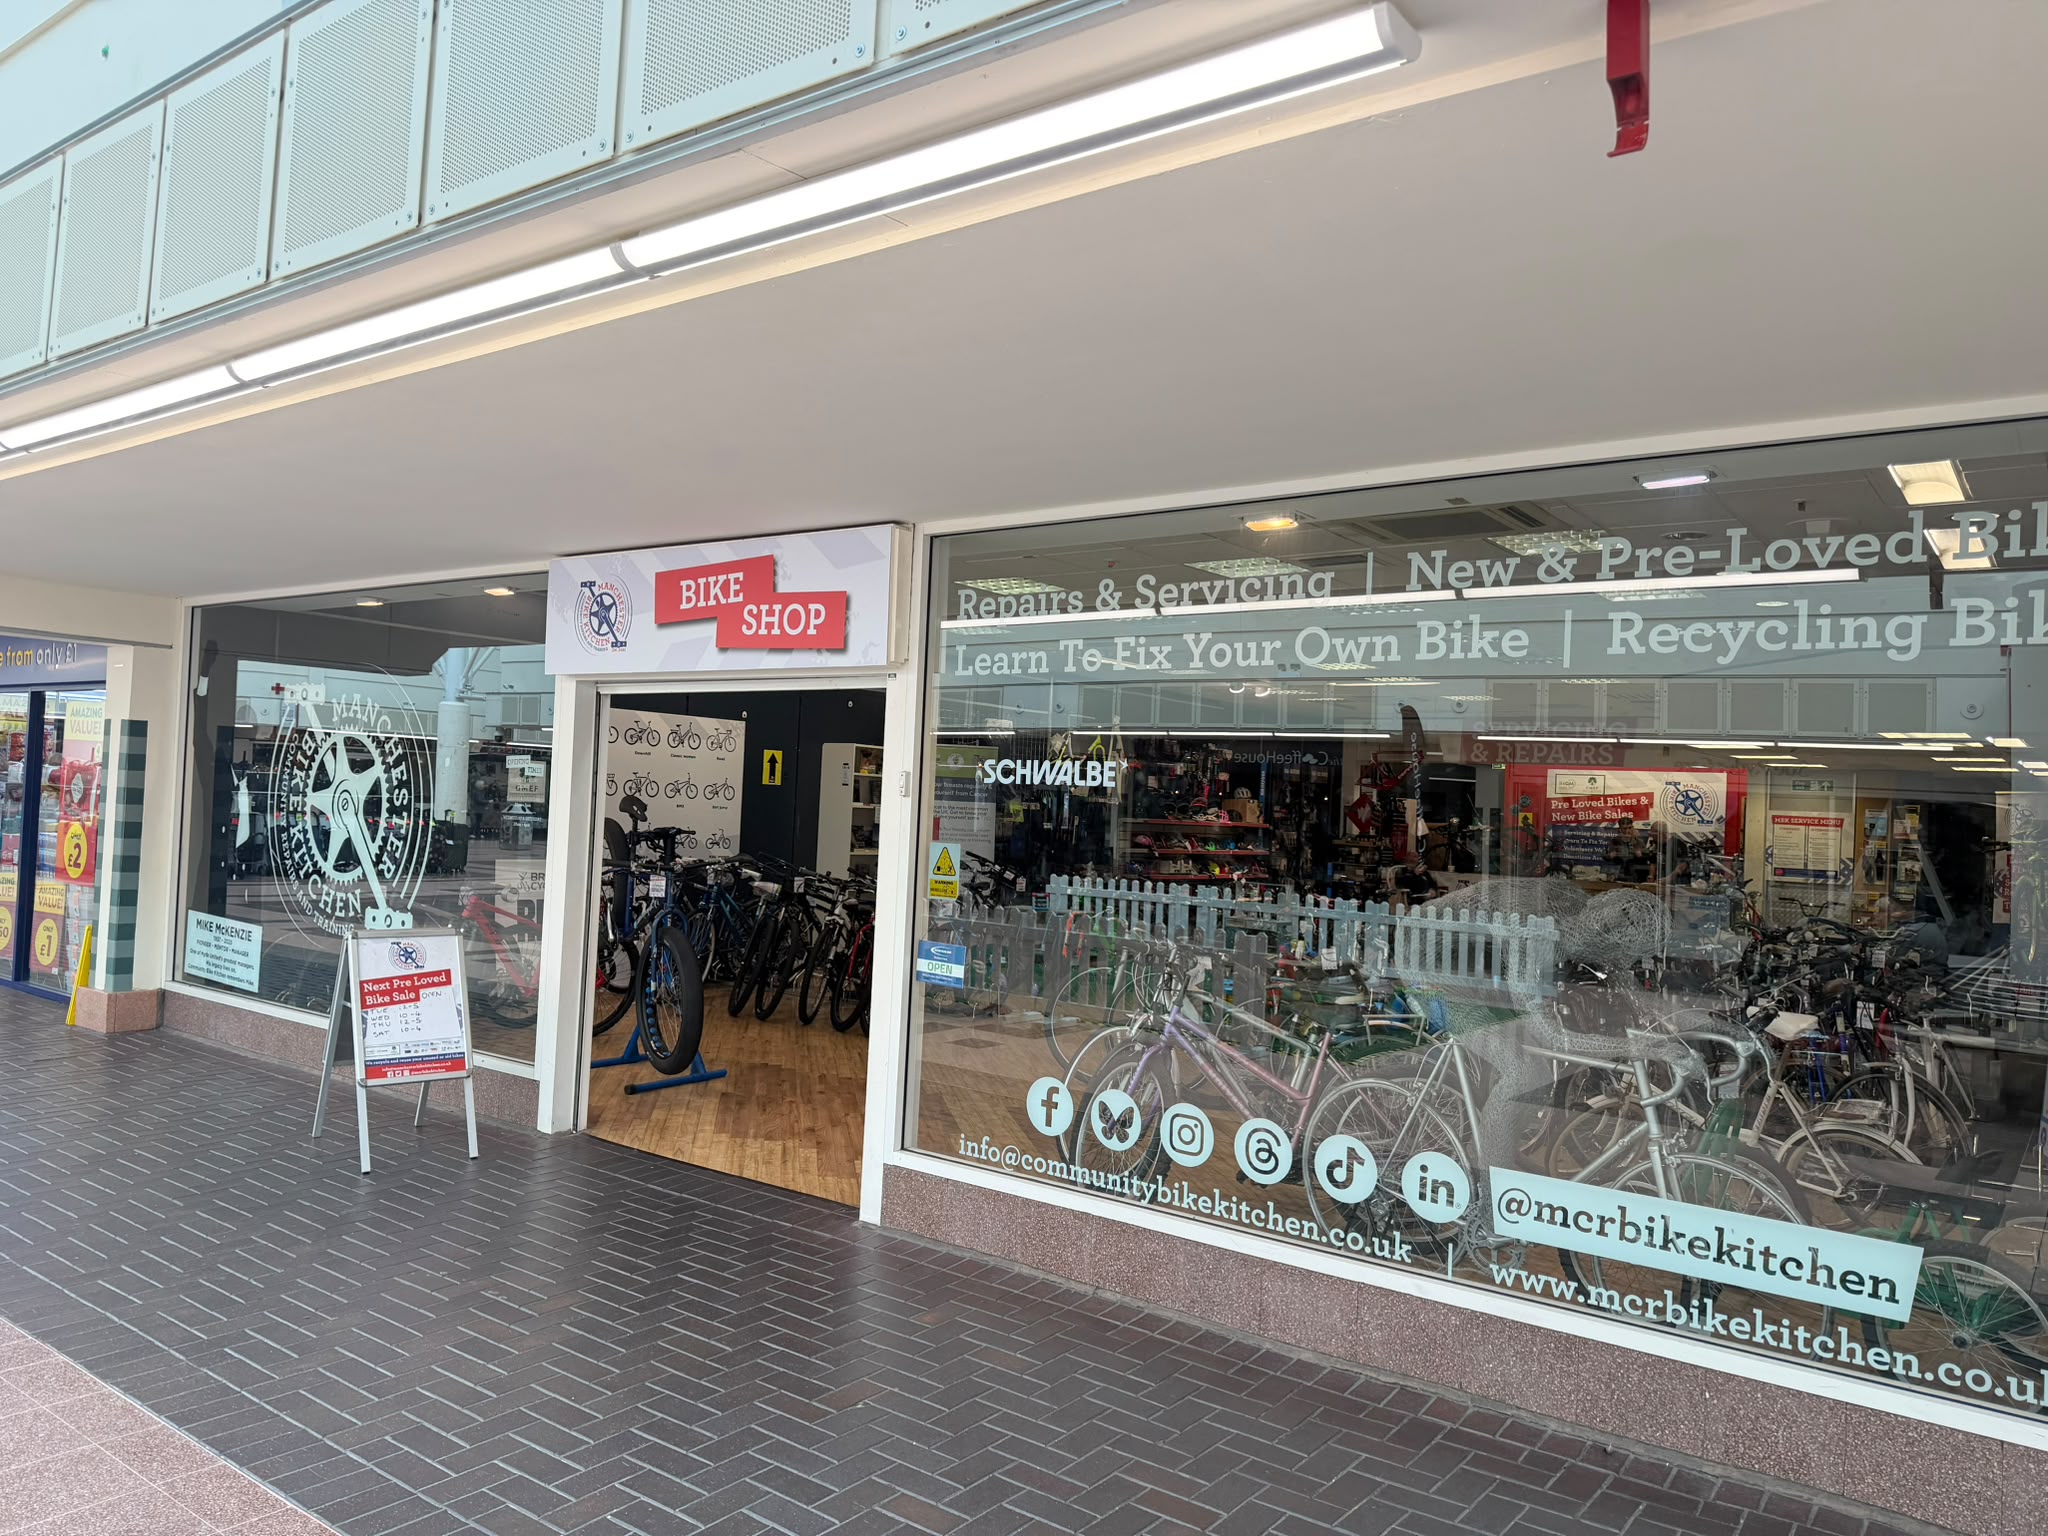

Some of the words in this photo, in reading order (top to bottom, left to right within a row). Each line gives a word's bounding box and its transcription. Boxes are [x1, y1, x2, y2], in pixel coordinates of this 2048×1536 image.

[1406, 550, 1520, 592] New
[1536, 544, 1578, 583] &
[1596, 510, 1927, 580] Pre-Loved
[680, 572, 744, 610] BIKE
[957, 584, 1084, 626] Repairs
[1096, 578, 1122, 612] &
[1135, 565, 1334, 610] Servicing
[598, 582, 624, 633] MANCHESTER
[742, 604, 826, 635] SHOP
[583, 622, 610, 646] KITCHEN
[955, 645, 1049, 676] Learn
[1060, 639, 1102, 672] To
[1112, 636, 1172, 671] Fix
[1183, 632, 1282, 668] Your
[1295, 626, 1400, 666] Own
[1416, 614, 1529, 661] Bike
[1607, 600, 1928, 665] Recycling
[6, 645, 33, 669] from
[36, 642, 62, 664] only
[66, 643, 77, 663] £1
[71, 706, 102, 718] AMAZING
[1471, 743, 1488, 762] &
[1496, 743, 1614, 765] REPAIRS
[280, 734, 299, 827] COMMUNITY
[289, 731, 316, 812] BIKE
[982, 759, 1116, 788] SCHWALBE
[332, 693, 408, 880] MANCHESTER
[1683, 784, 1710, 816] MANCHESTER
[1551, 800, 1569, 809] Pre
[1572, 797, 1604, 808] Loved
[1607, 796, 1637, 806] Bikes
[1640, 796, 1648, 804] &
[1552, 813, 1575, 821] New
[1578, 811, 1602, 820] Bike
[1605, 809, 1634, 819] Sales
[68, 843, 82, 869] £2
[281, 832, 299, 890] REPAIRS
[290, 823, 360, 917] KITCHEN
[38, 886, 64, 897] AMAZING
[38, 896, 63, 910] VALUE!
[297, 890, 312, 915] AND
[196, 918, 214, 932] MIKE
[215, 923, 252, 942] McKENZIE
[40, 934, 52, 957] £1
[363, 981, 390, 993] Next
[393, 978, 412, 989] Pre
[414, 972, 446, 986] Loved
[928, 962, 952, 974] OPEN
[366, 993, 390, 1005] Bike
[393, 989, 416, 1001] Sale
[958, 1134, 1412, 1264] info@communitybikekitchen.co.uk
[1497, 1186, 1901, 1305] @mcrbikekitchen
